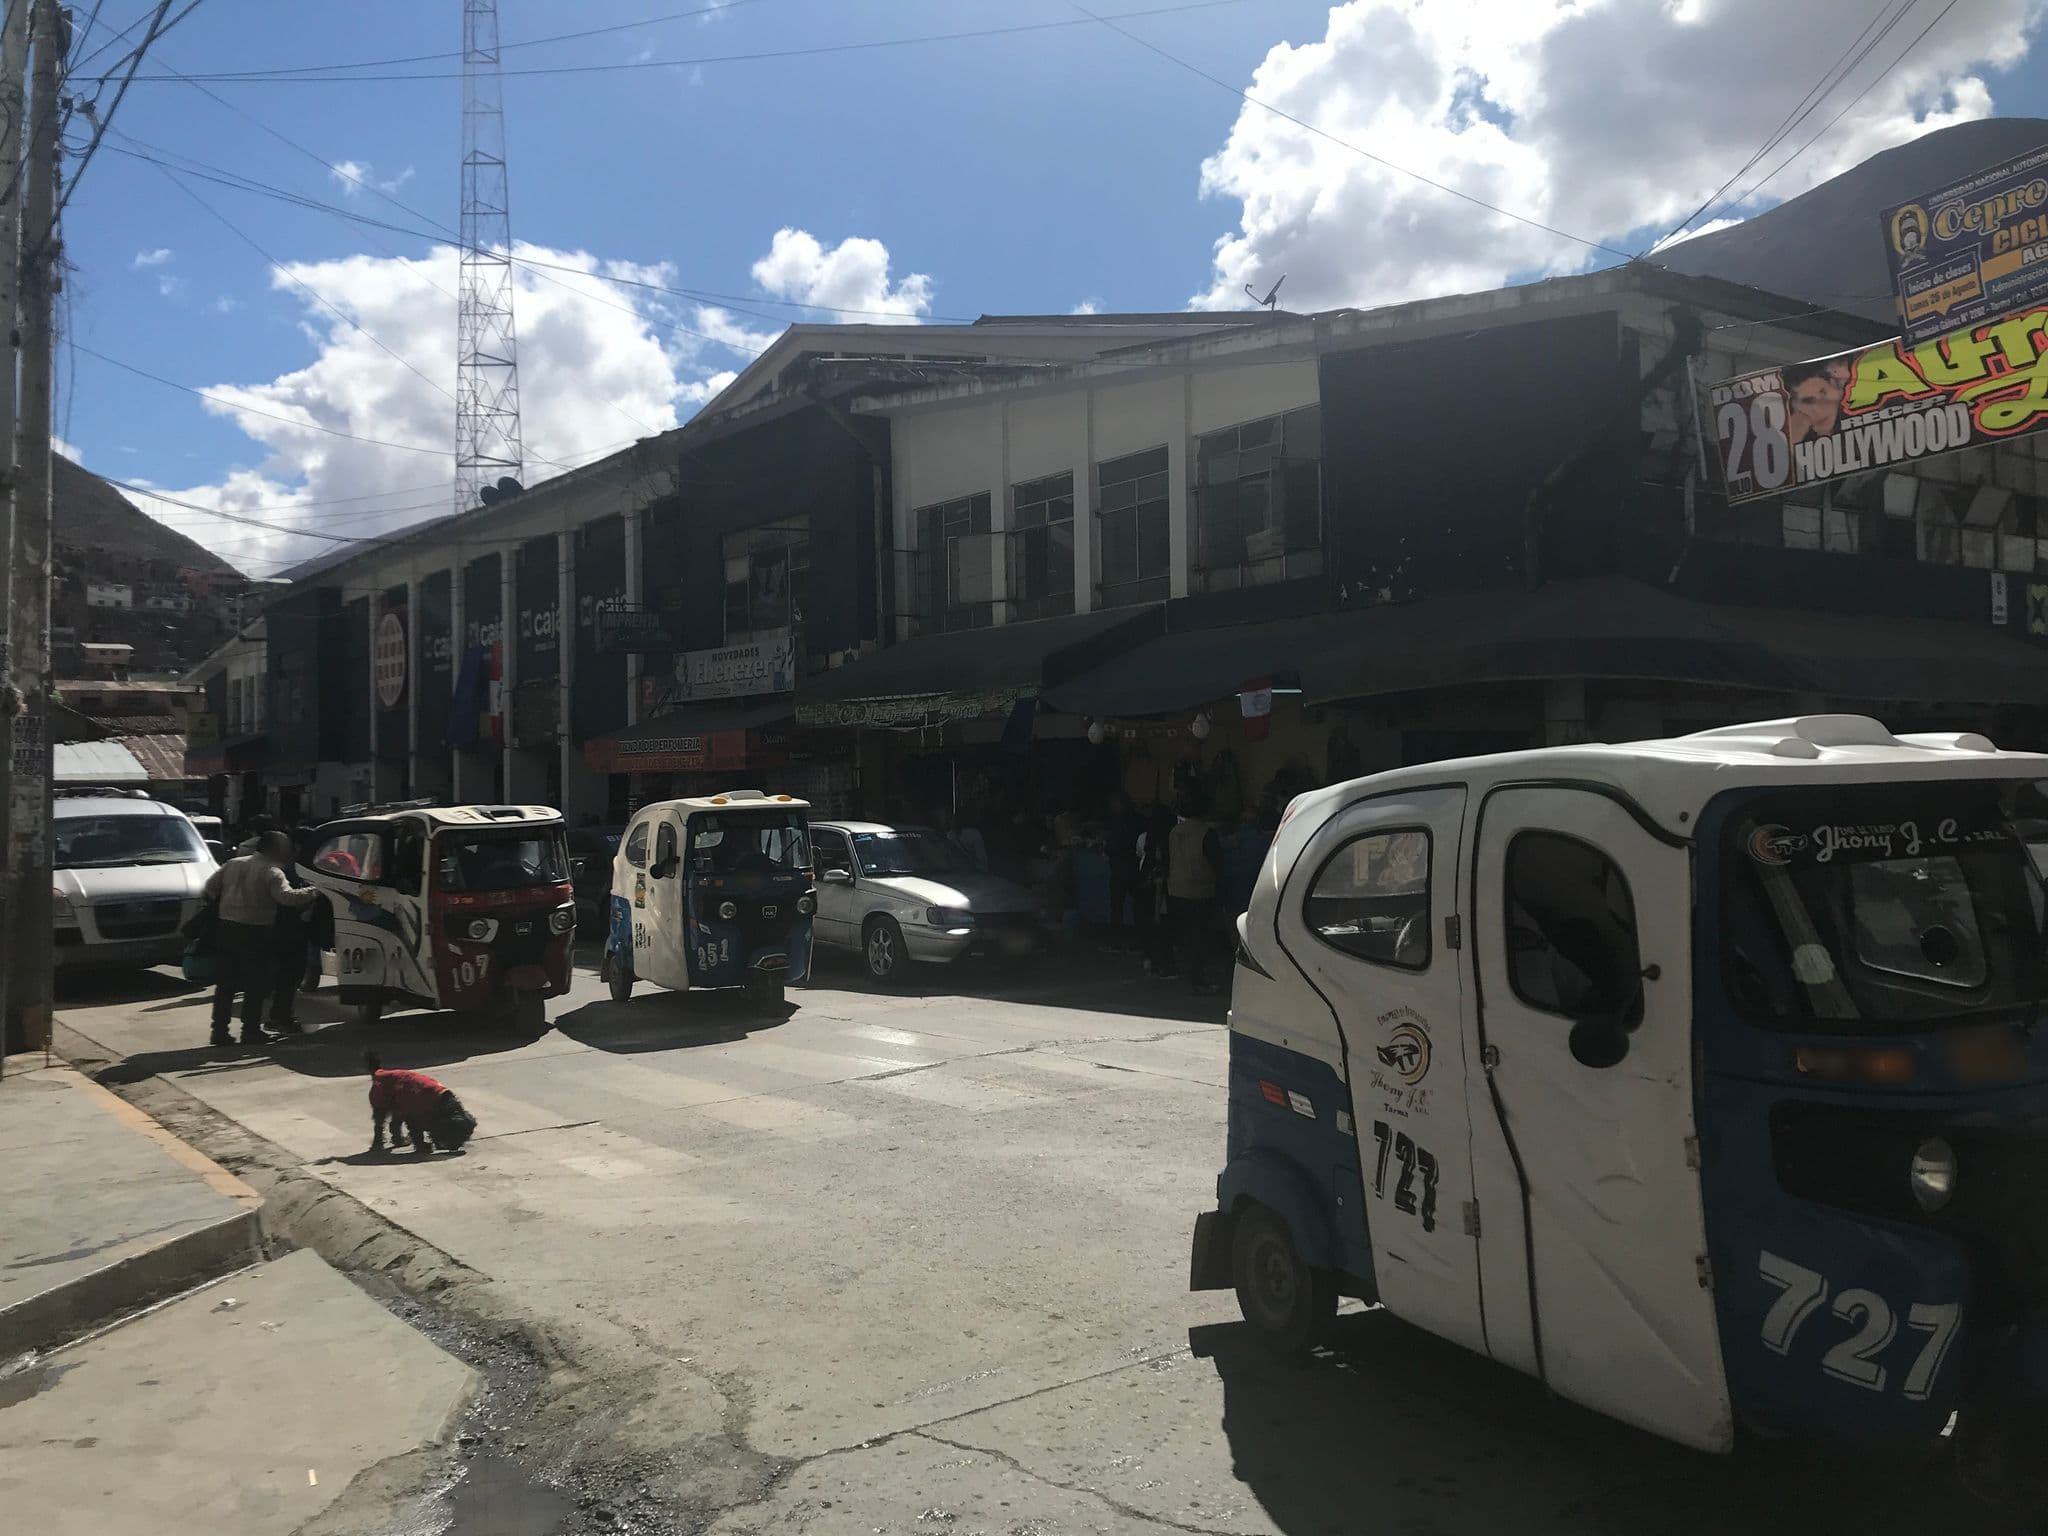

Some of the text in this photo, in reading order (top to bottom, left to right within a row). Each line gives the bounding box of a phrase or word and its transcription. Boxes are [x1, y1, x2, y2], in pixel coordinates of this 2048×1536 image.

[1974, 168, 2010, 187] NACIONAL
[1933, 178, 2048, 240] Cepre
[1712, 372, 1781, 405] DOM
[1717, 391, 1790, 489] 28
[1795, 402, 1972, 483] HOLLYWOOD
[712, 646, 760, 662] NOVEDADES
[1813, 825, 1892, 863] Jhony
[451, 953, 489, 992] 107
[698, 938, 729, 971] 251
[1374, 1119, 1439, 1233] 727
[1759, 1249, 1963, 1401] 727
